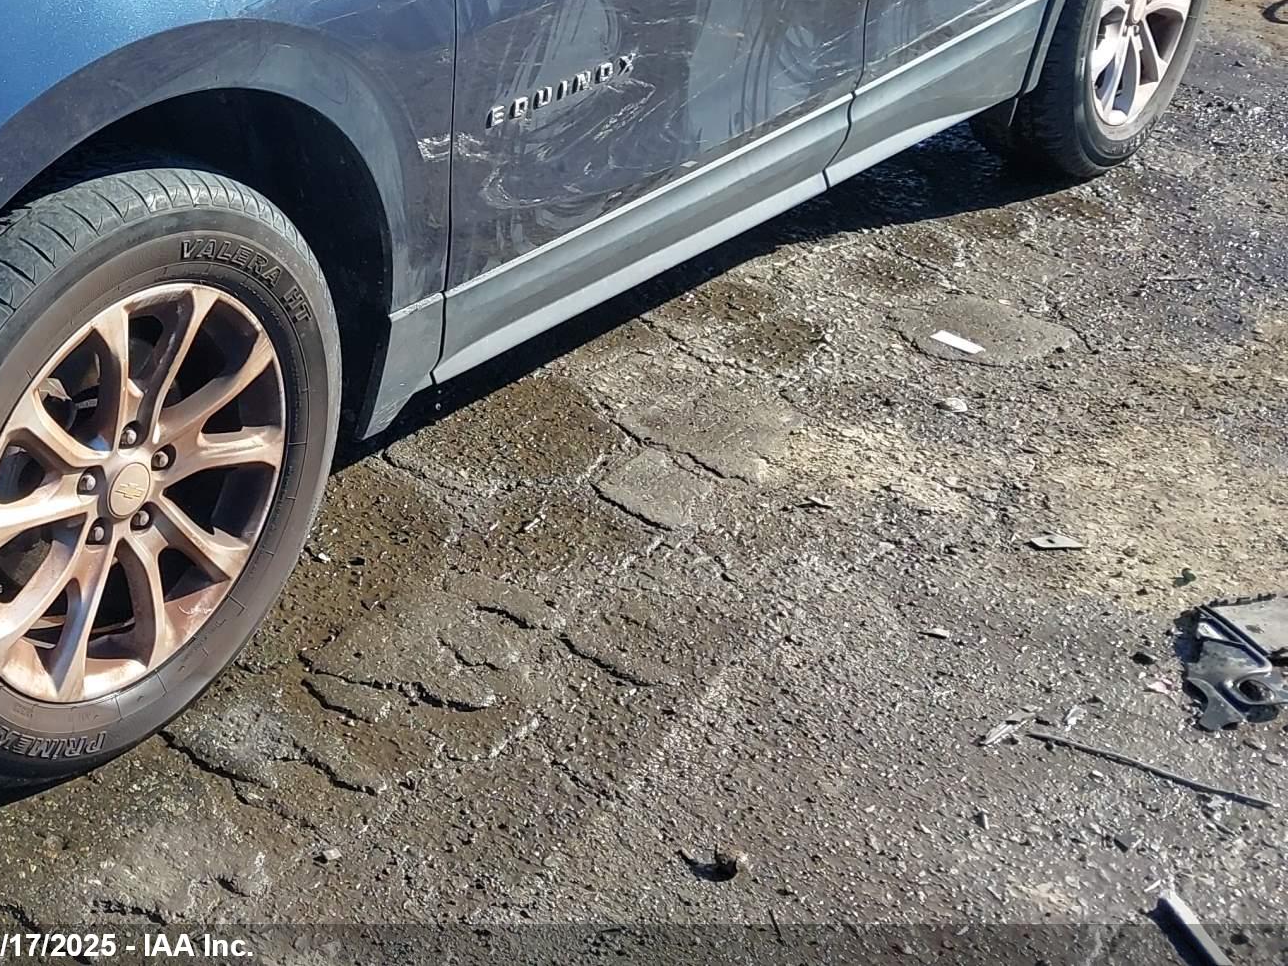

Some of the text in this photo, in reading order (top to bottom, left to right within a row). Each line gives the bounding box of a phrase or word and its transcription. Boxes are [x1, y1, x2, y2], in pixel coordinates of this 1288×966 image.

[486, 52, 637, 129] EQUINOX
[181, 239, 312, 323] VALERA HT
